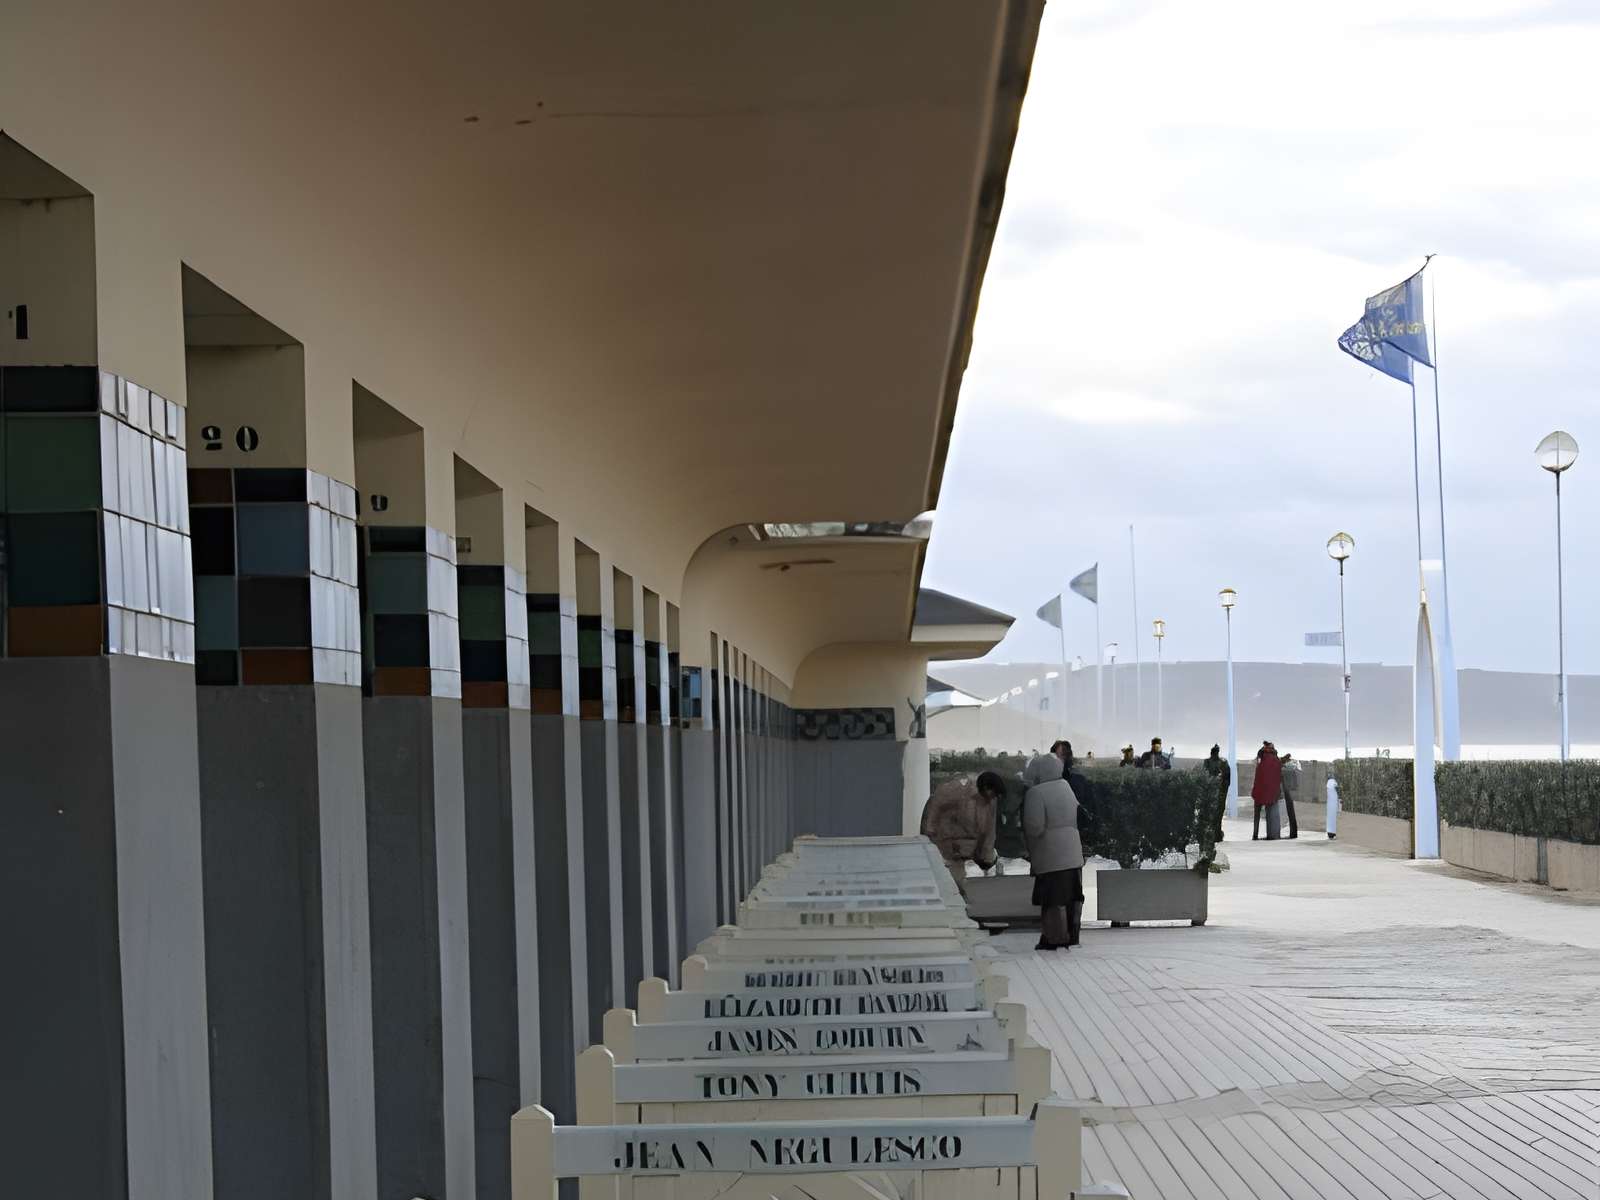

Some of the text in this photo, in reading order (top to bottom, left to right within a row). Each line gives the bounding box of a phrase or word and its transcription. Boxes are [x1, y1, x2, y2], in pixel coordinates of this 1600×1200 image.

[201, 424, 260, 453] 20
[696, 1072, 787, 1098] TONY
[613, 1138, 716, 1169] JEAN
